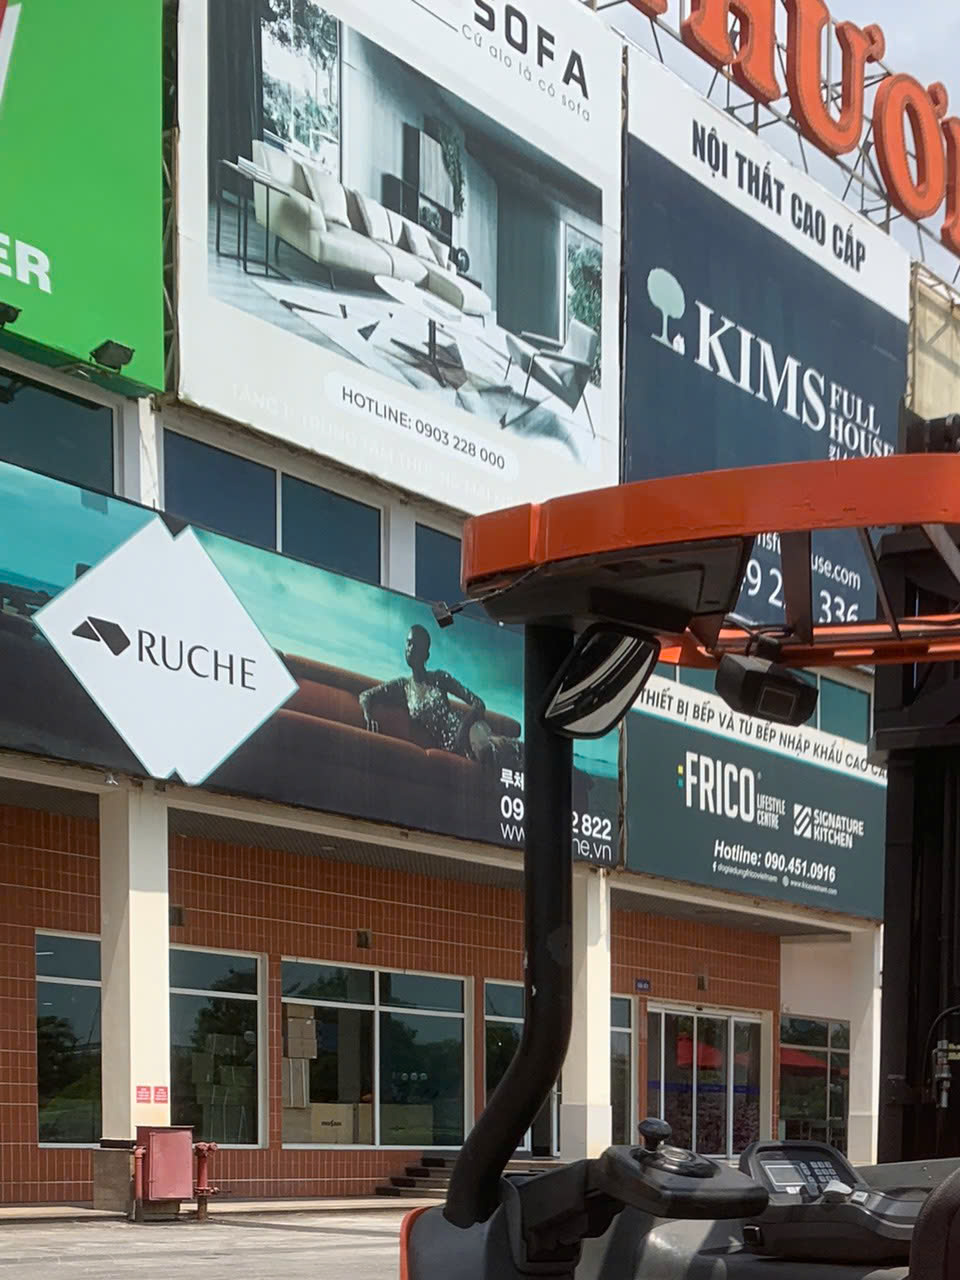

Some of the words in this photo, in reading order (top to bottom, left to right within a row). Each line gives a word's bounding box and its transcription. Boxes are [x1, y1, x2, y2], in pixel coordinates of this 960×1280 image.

[474, 0, 589, 100] SOFA
[562, 94, 590, 122] sofa
[692, 119, 728, 179] NỘI
[735, 151, 785, 216] THẤT
[791, 192, 826, 247] CAO
[832, 223, 866, 272] CẤP
[694, 299, 827, 432] KIMS
[342, 385, 412, 430] HOTLINE:
[415, 418, 450, 446] 0903
[453, 434, 477, 458] 228
[479, 447, 506, 470] 000
[829, 381, 881, 435] FULL
[138, 629, 257, 691] RUCHE
[639, 687, 674, 715] THIẾT
[676, 699, 689, 723] BỊ
[692, 700, 715, 727] BẾP
[718, 711, 735, 732] VÀ
[778, 731, 811, 757] NHẬP
[845, 753, 869, 773] CAO
[685, 751, 755, 823] FRICO
[756, 793, 786, 816] LIFESTYLE
[756, 812, 780, 831] CENTRE
[813, 808, 865, 836] SIGNATURE
[813, 825, 853, 849] KITCHEN
[713, 839, 761, 867] Hotline:
[764, 851, 836, 883] 090.451.0916
